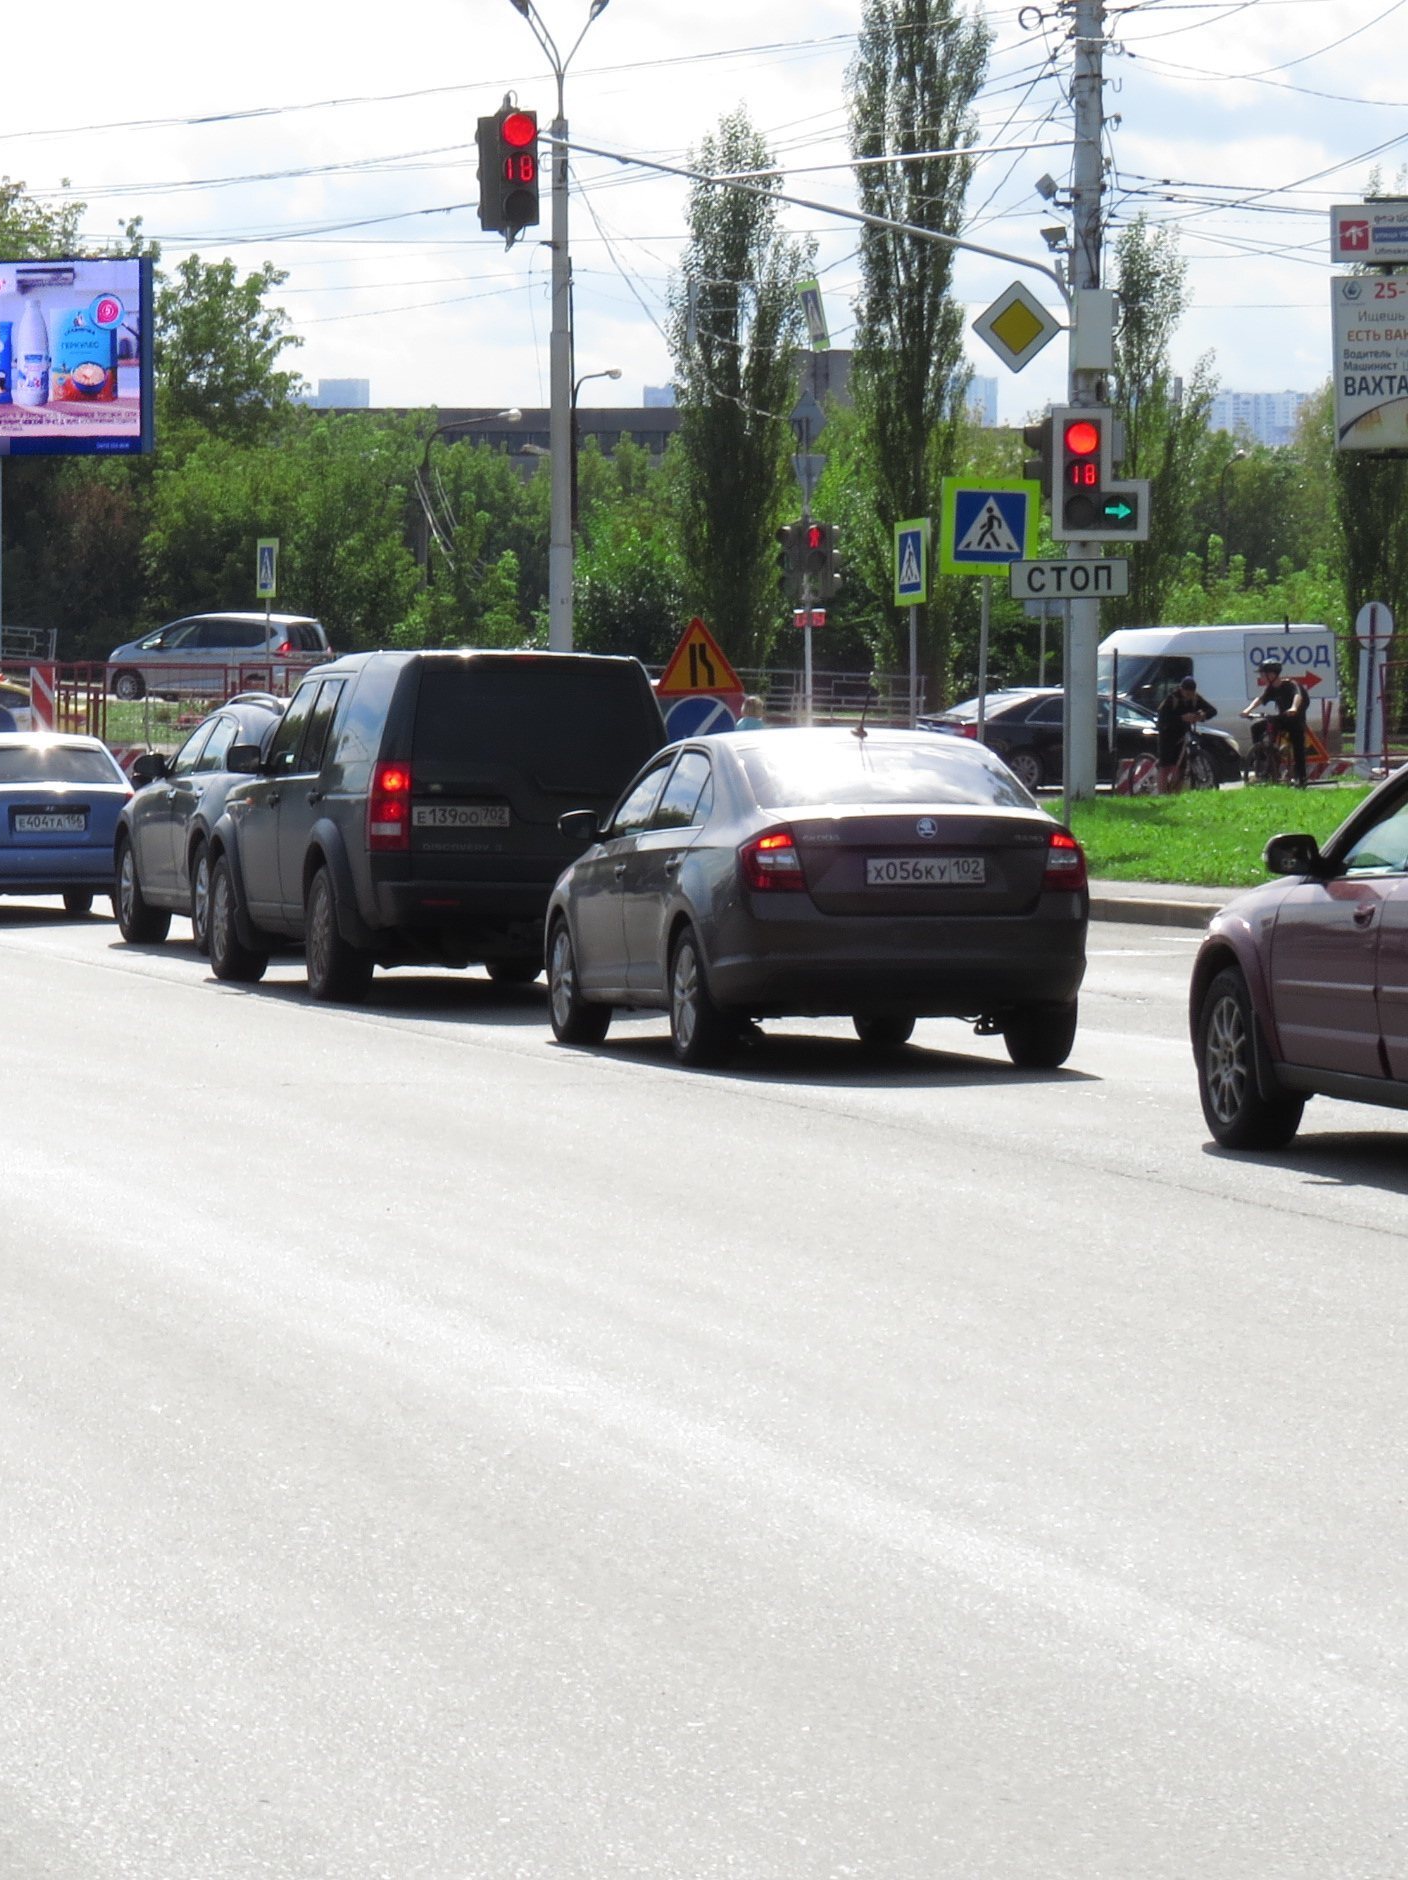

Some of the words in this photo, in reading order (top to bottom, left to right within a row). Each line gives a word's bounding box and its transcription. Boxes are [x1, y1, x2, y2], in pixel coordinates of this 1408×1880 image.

[506, 154, 534, 181] 18
[1374, 282, 1408, 299] 25-
[1358, 311, 1405, 322] Ищешь
[1347, 330, 1381, 341] ЕСТЬ
[1343, 349, 1391, 359] Водитель
[1343, 361, 1397, 371] Машинист
[1072, 463, 1097, 486] 18
[1027, 565, 1112, 592] СТОП
[1249, 645, 1331, 667] ОБХОД
